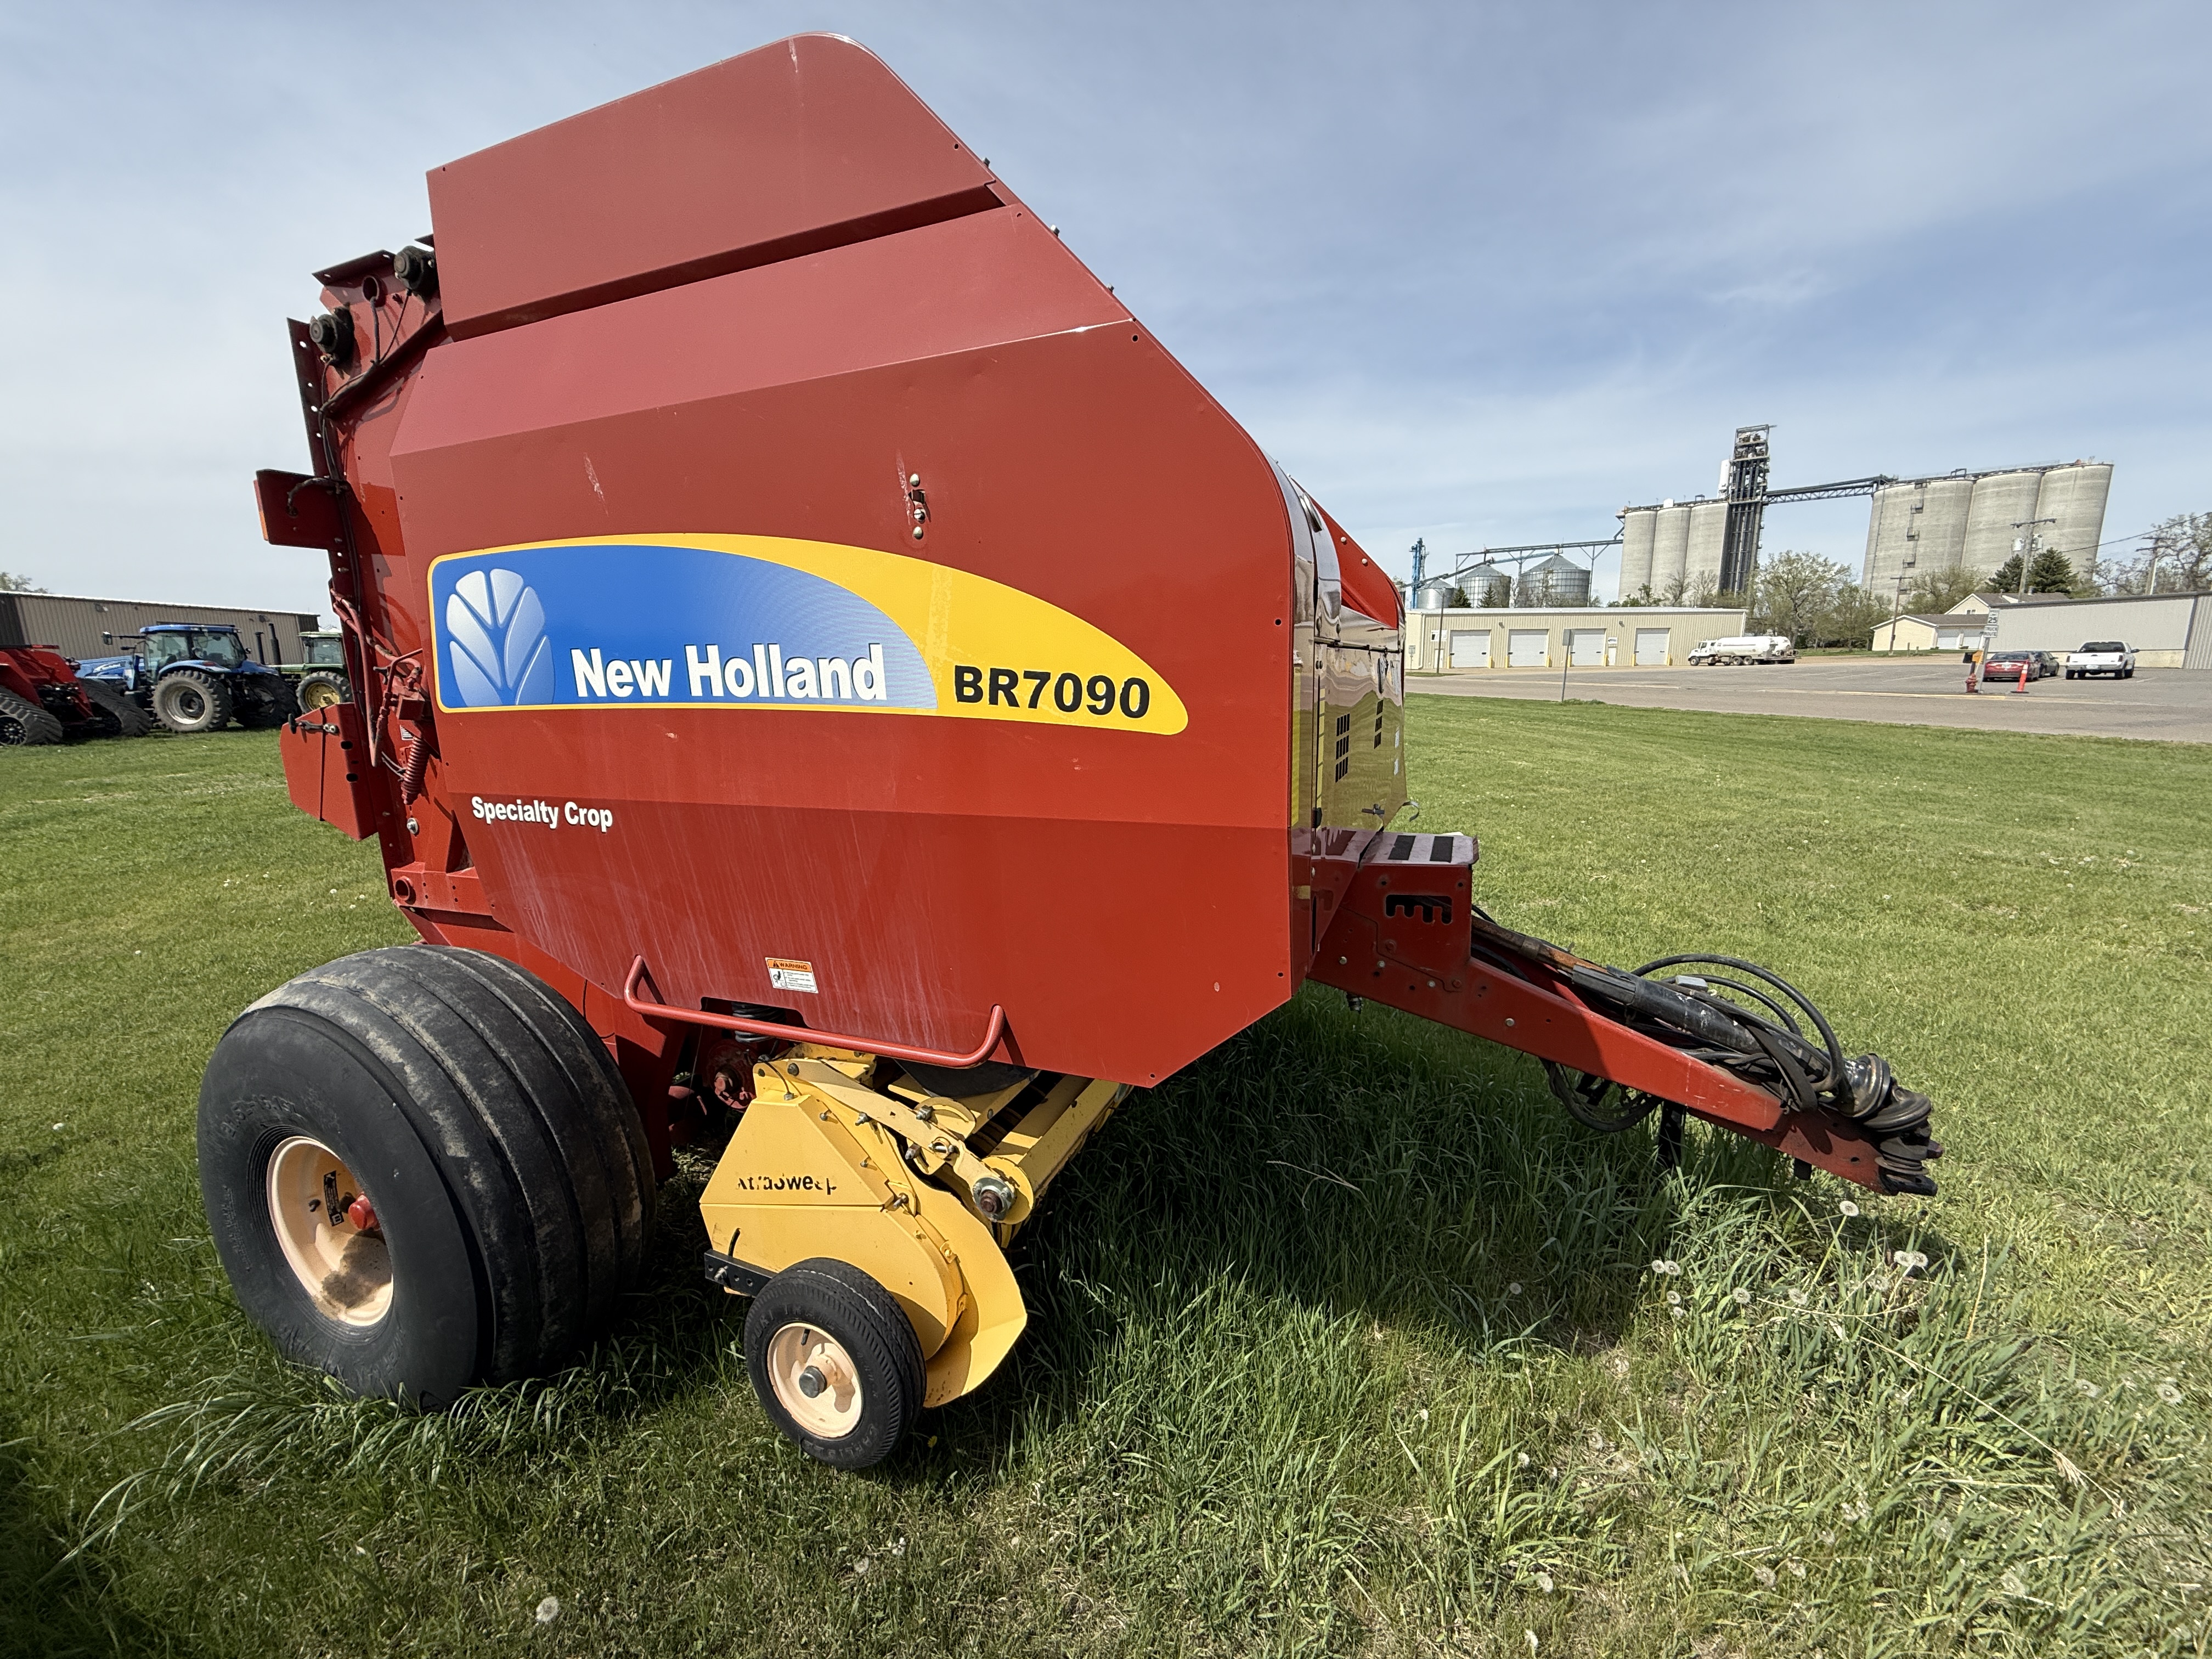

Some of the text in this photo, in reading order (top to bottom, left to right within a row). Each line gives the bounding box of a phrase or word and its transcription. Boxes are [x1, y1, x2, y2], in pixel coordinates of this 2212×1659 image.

[570, 643, 887, 701] New Holland
[955, 664, 1150, 719] BR7090
[471, 796, 613, 833] Specialty Crop
